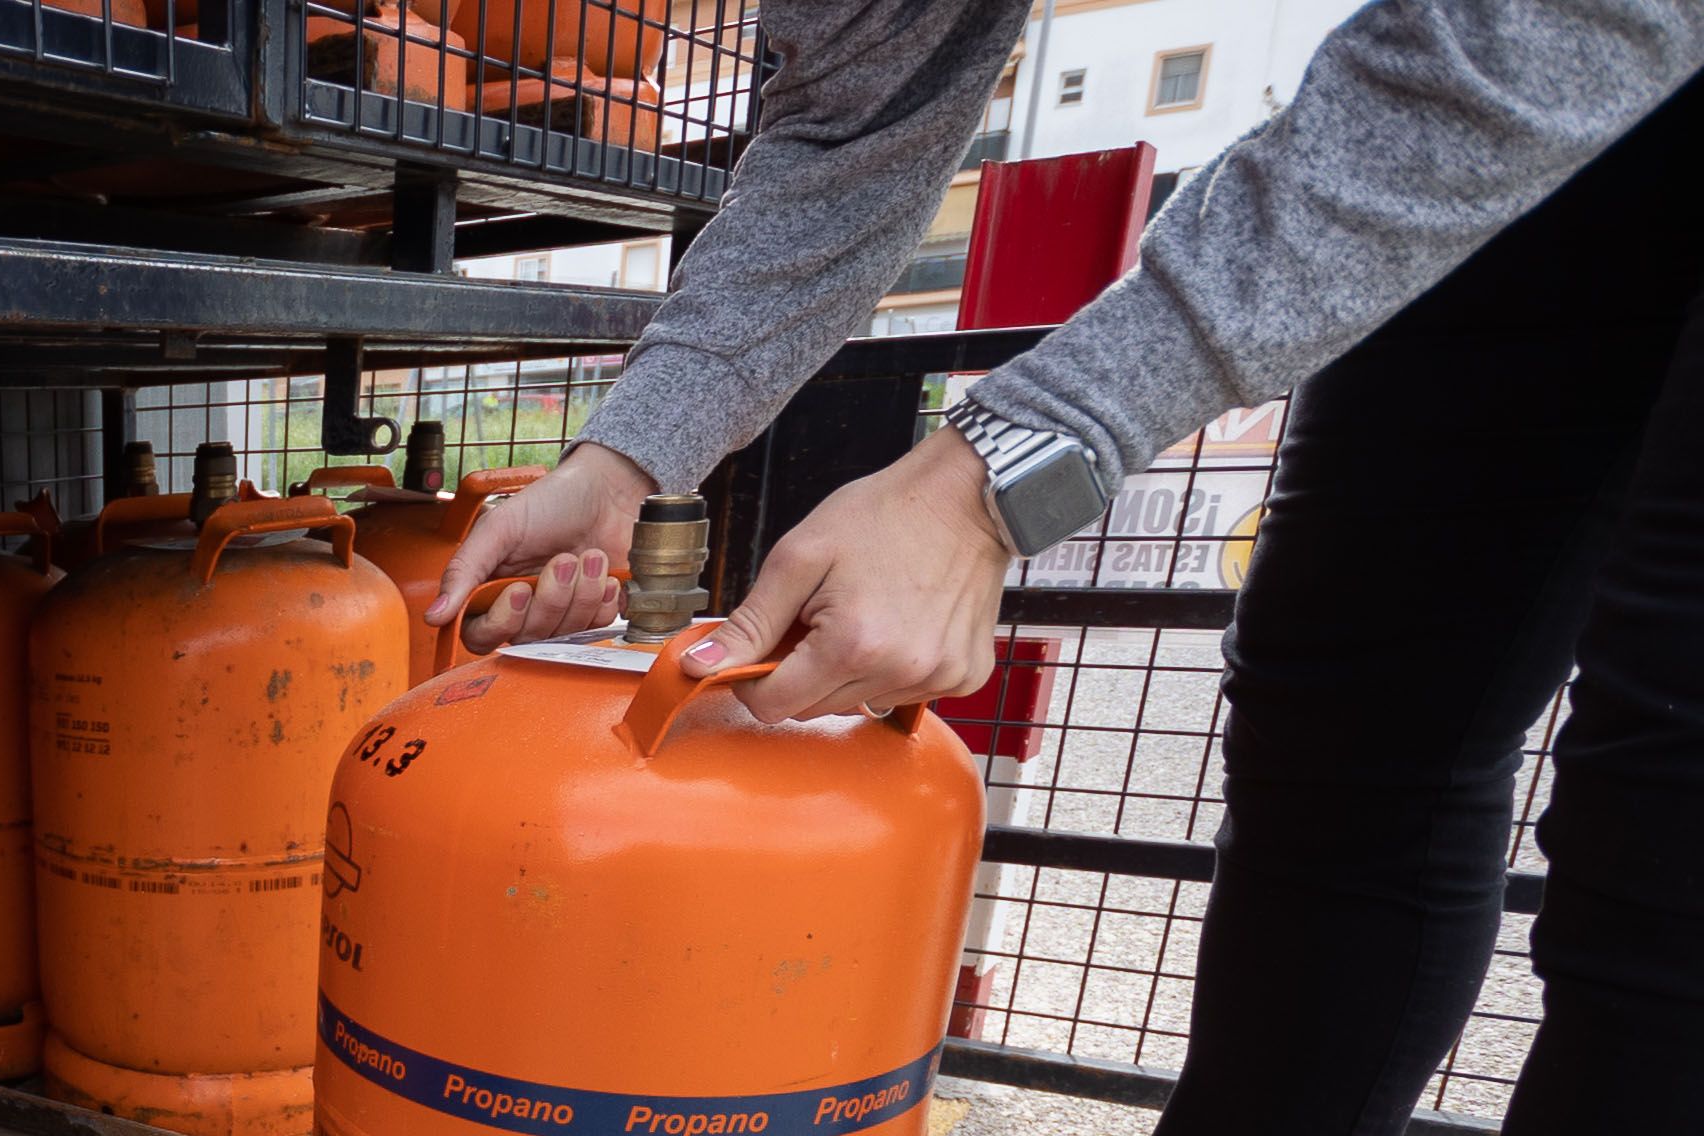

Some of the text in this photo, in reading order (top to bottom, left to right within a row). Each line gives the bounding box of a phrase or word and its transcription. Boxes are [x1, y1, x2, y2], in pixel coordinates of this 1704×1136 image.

[352, 722, 428, 778] 13.3
[334, 1020, 408, 1081] Propano
[443, 1073, 575, 1127] Propano
[813, 1076, 911, 1126] Propano
